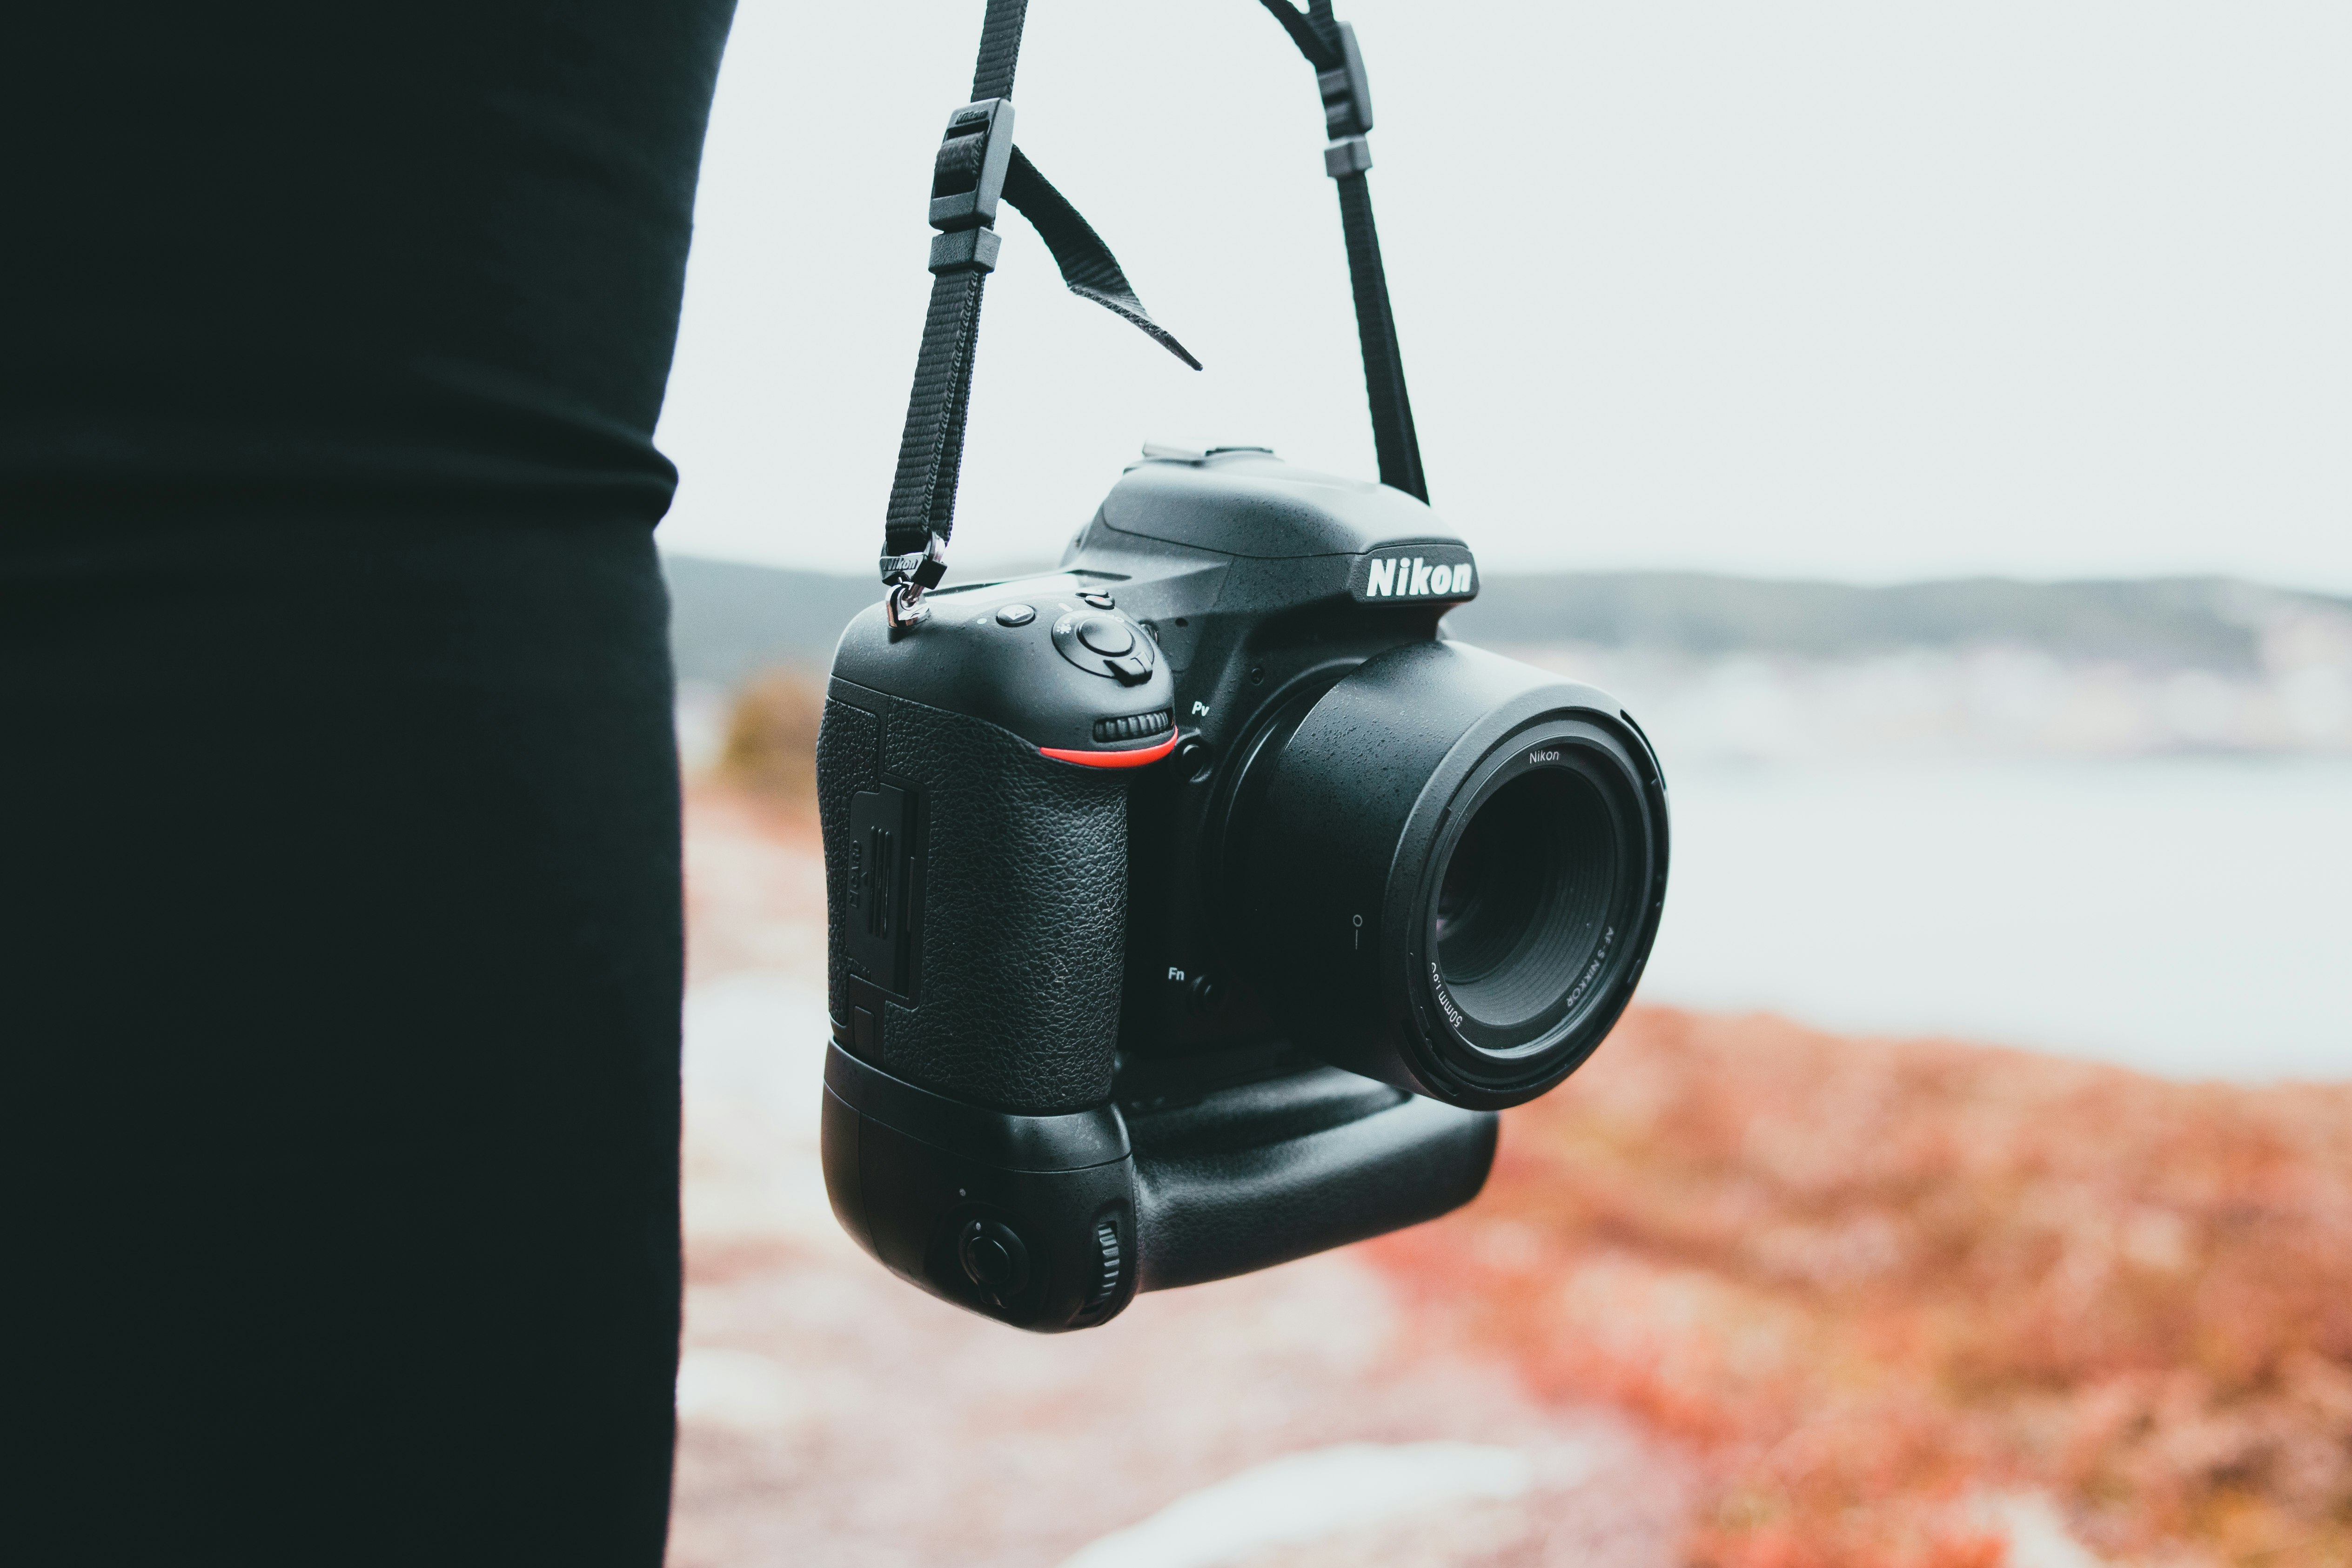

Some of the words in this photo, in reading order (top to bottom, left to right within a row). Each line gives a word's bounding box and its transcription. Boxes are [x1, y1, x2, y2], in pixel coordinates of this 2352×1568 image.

[955, 111, 988, 124] Nikon
[884, 557, 919, 571] Nikon
[1367, 557, 1472, 597] Nikon
[1192, 701, 1210, 717] Pv
[1529, 750, 1560, 764] Nikon
[1168, 966, 1185, 981] Fn
[1566, 960, 1602, 1007] NIKKOR
[1438, 990, 1463, 1028] 50mm
